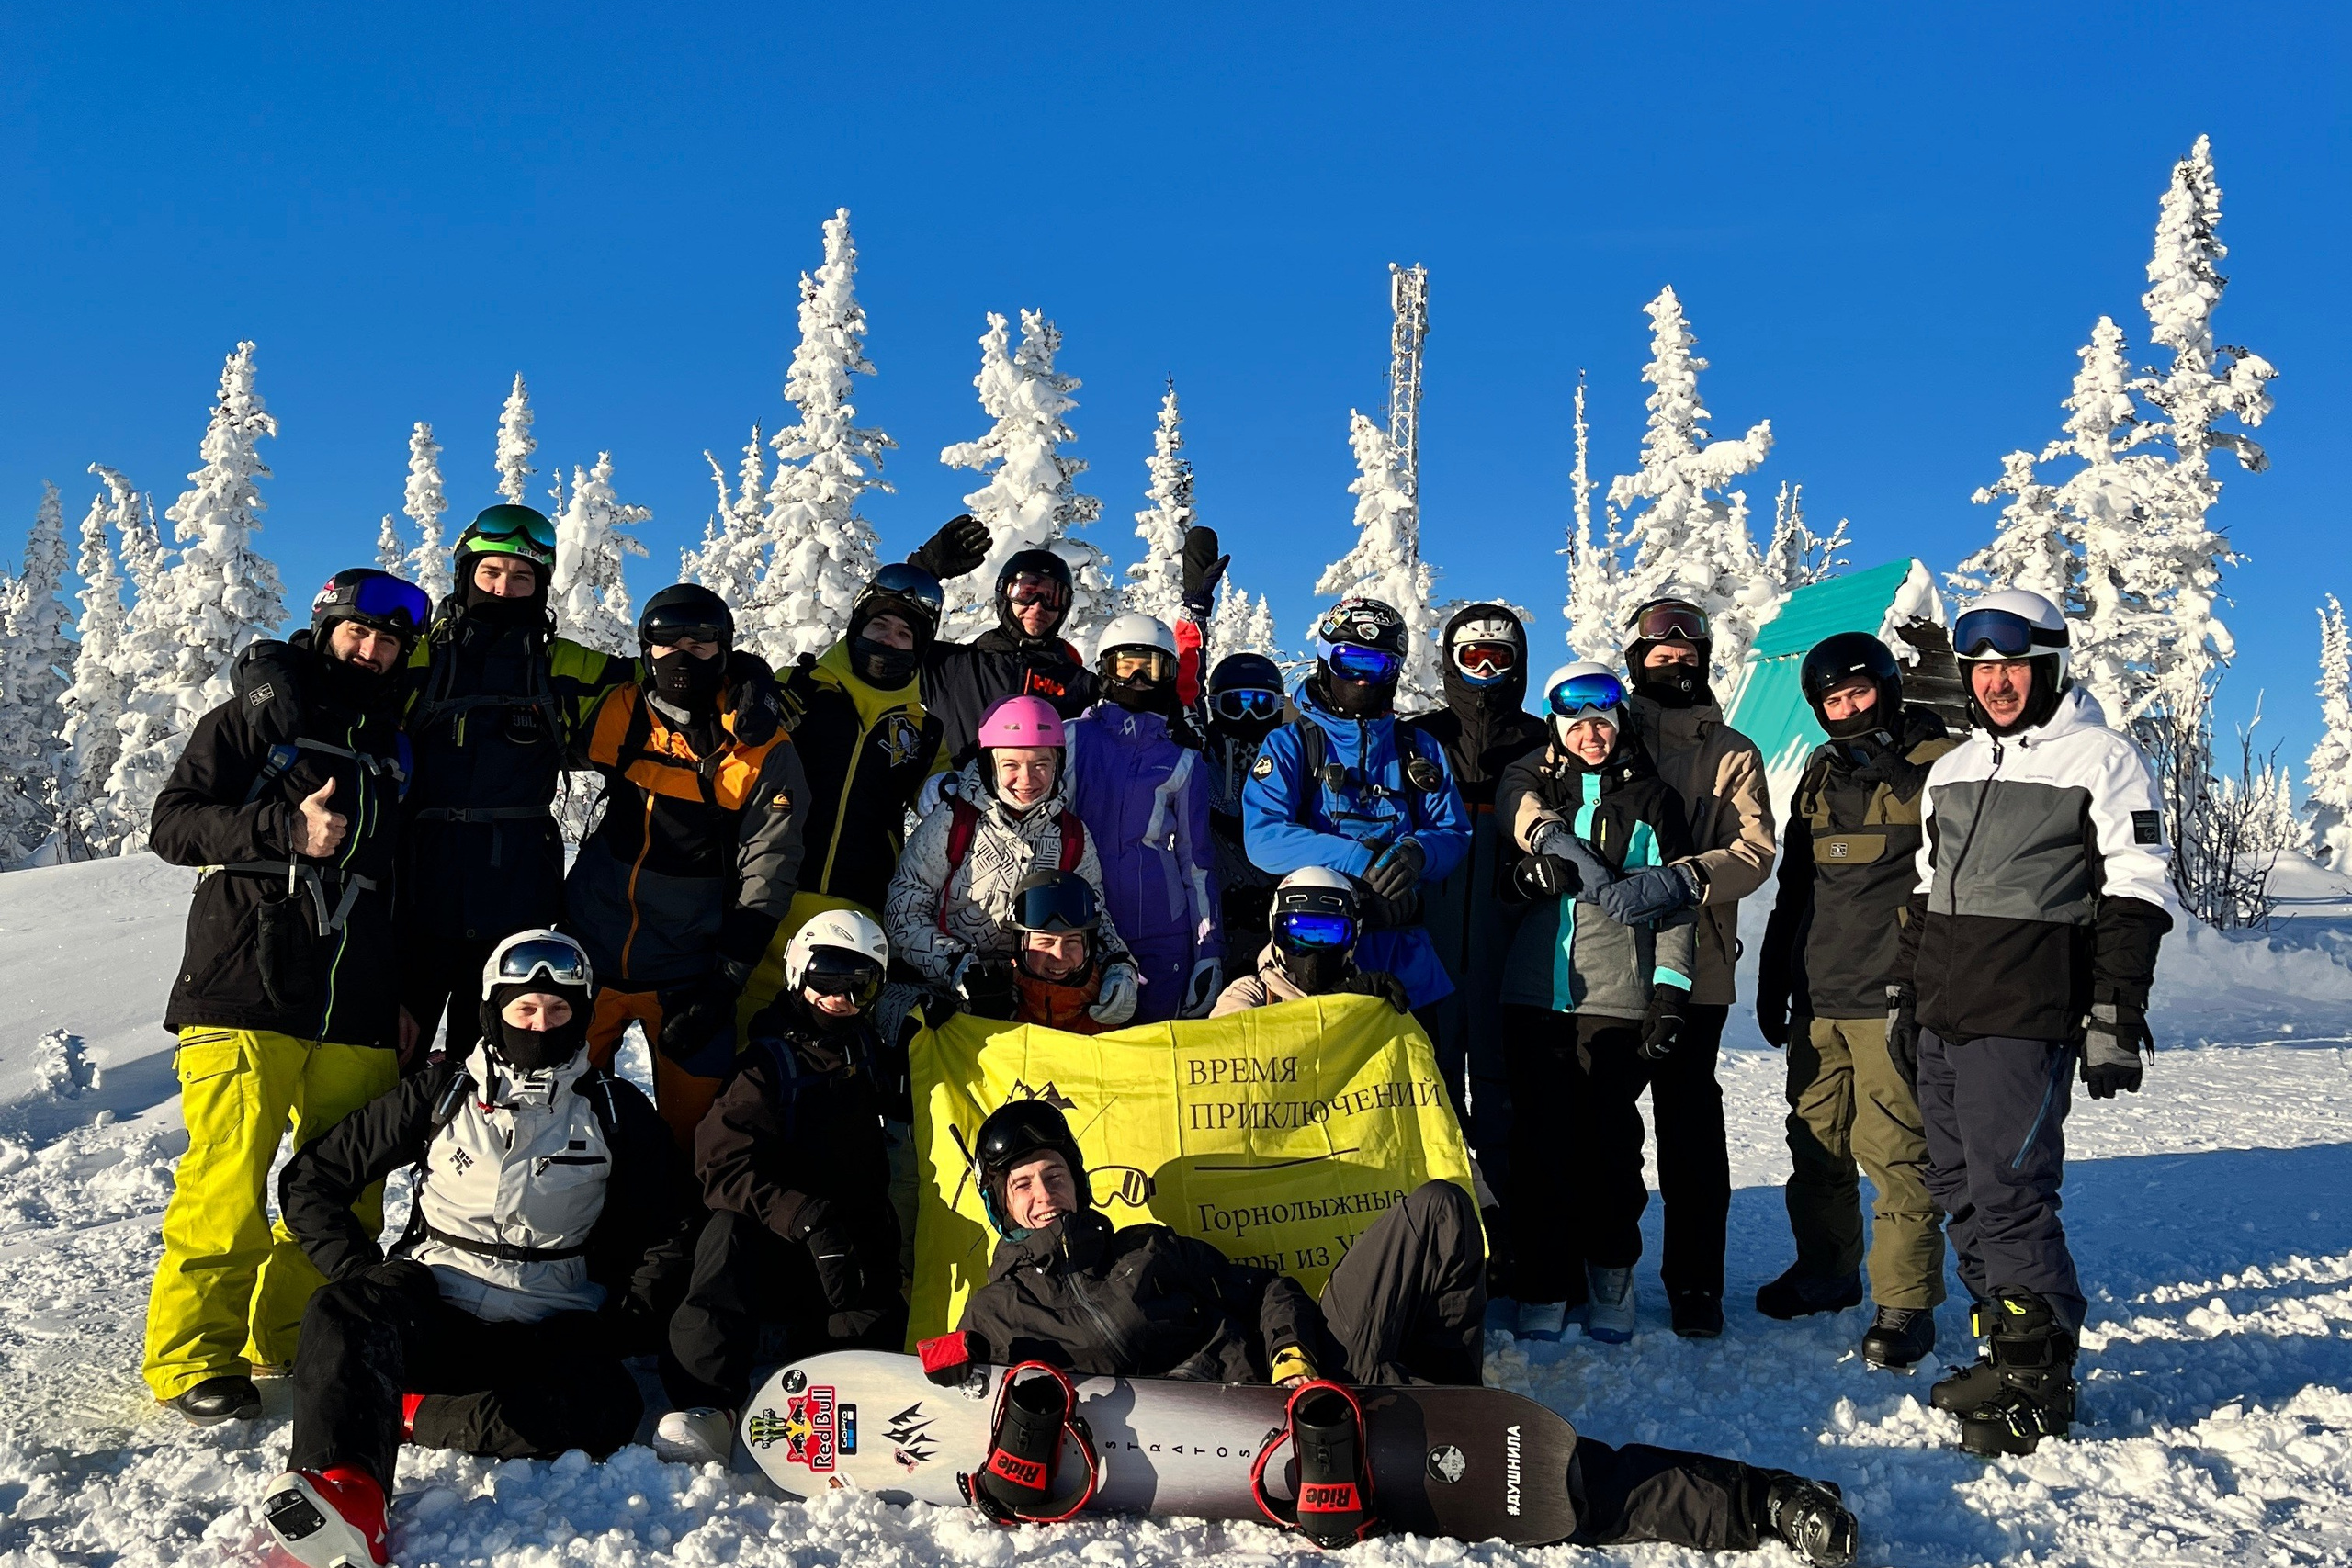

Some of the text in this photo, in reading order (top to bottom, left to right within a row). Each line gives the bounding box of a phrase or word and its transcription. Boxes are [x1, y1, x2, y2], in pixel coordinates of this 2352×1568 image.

[1188, 1056, 1298, 1085] ВРЕМЯ
[1190, 1077, 1443, 1130] ПРИКЛЮЧЕНИЙ
[1295, 1247, 1330, 1269] из
[812, 1390, 833, 1468] Red Bull
[1105, 1441, 1250, 1458] STRATOS
[997, 1455, 1040, 1483] Ride
[1507, 1425, 1521, 1516] #ДУШНИЛА
[1306, 1487, 1351, 1507] Ride
